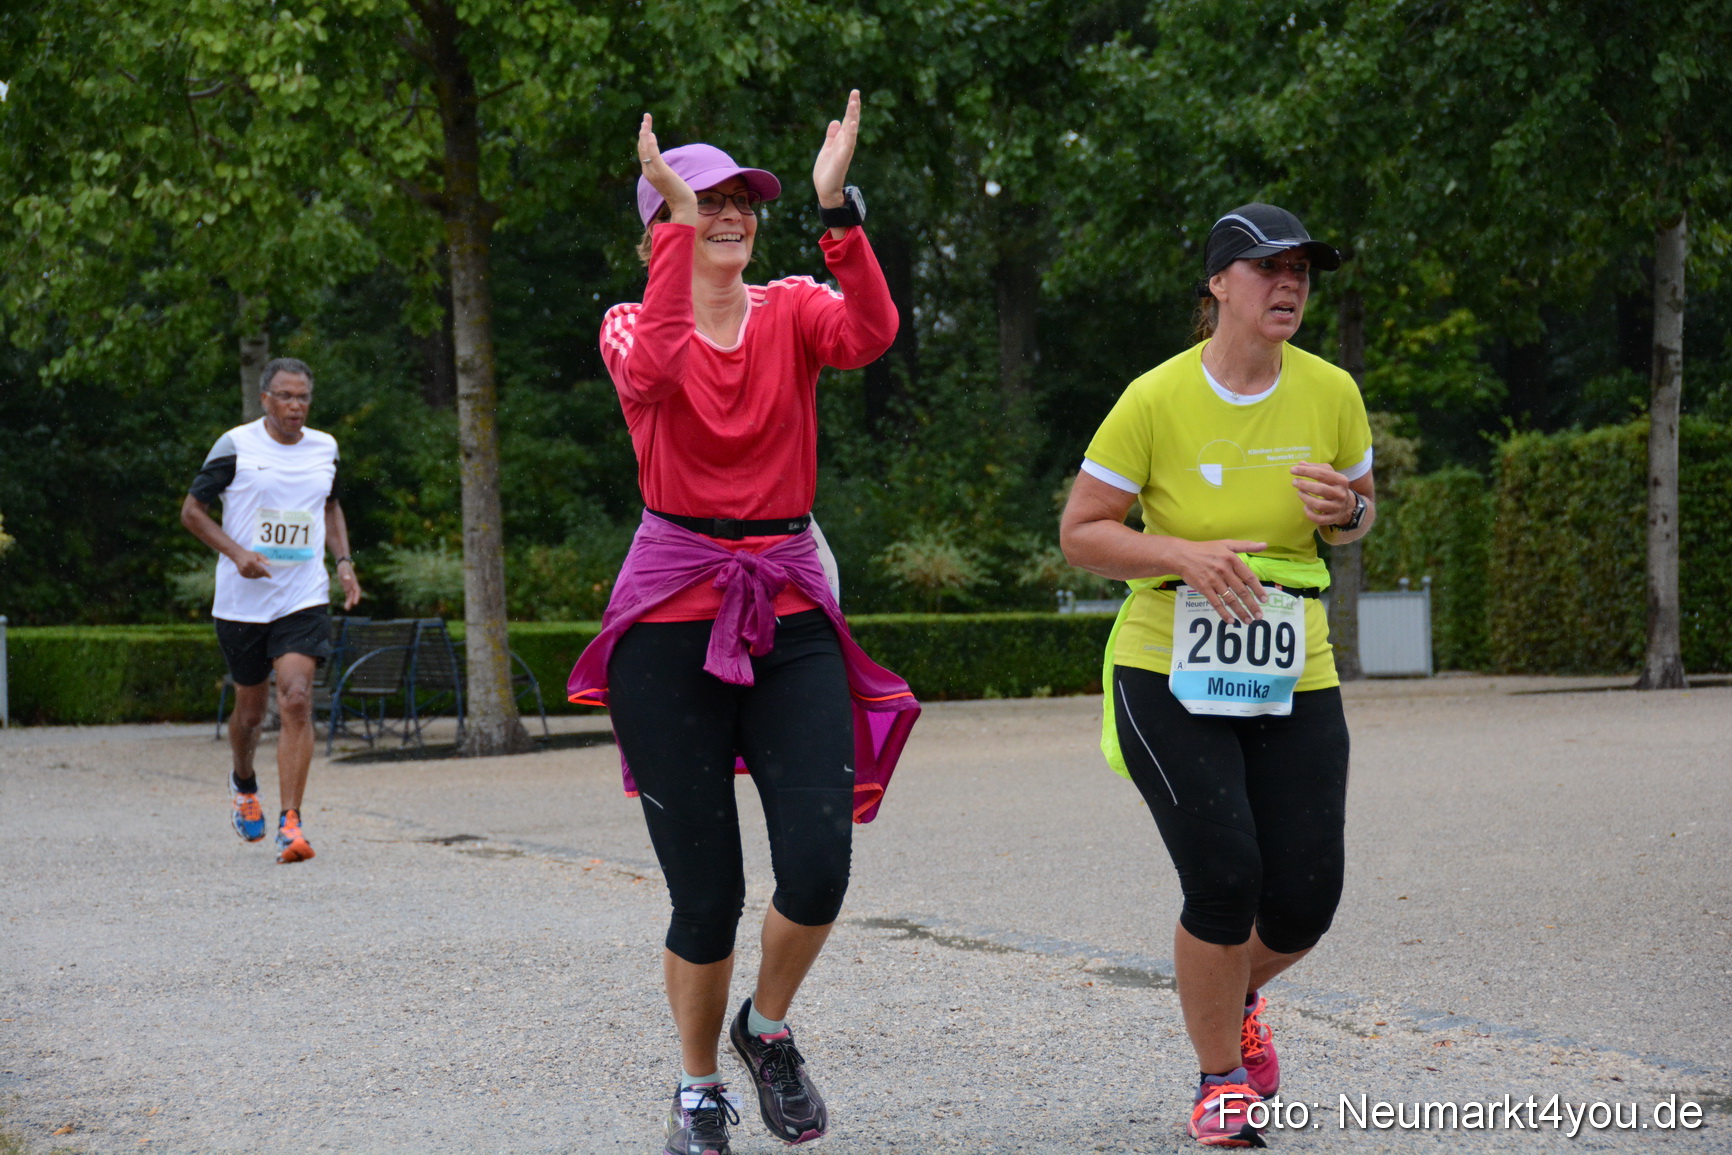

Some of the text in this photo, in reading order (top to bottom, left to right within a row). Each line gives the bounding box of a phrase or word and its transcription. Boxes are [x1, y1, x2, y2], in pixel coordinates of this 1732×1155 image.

[261, 522, 309, 545] 3071
[1187, 617, 1296, 669] 2609
[1177, 661, 1183, 670] A
[1207, 676, 1270, 699] Monika
